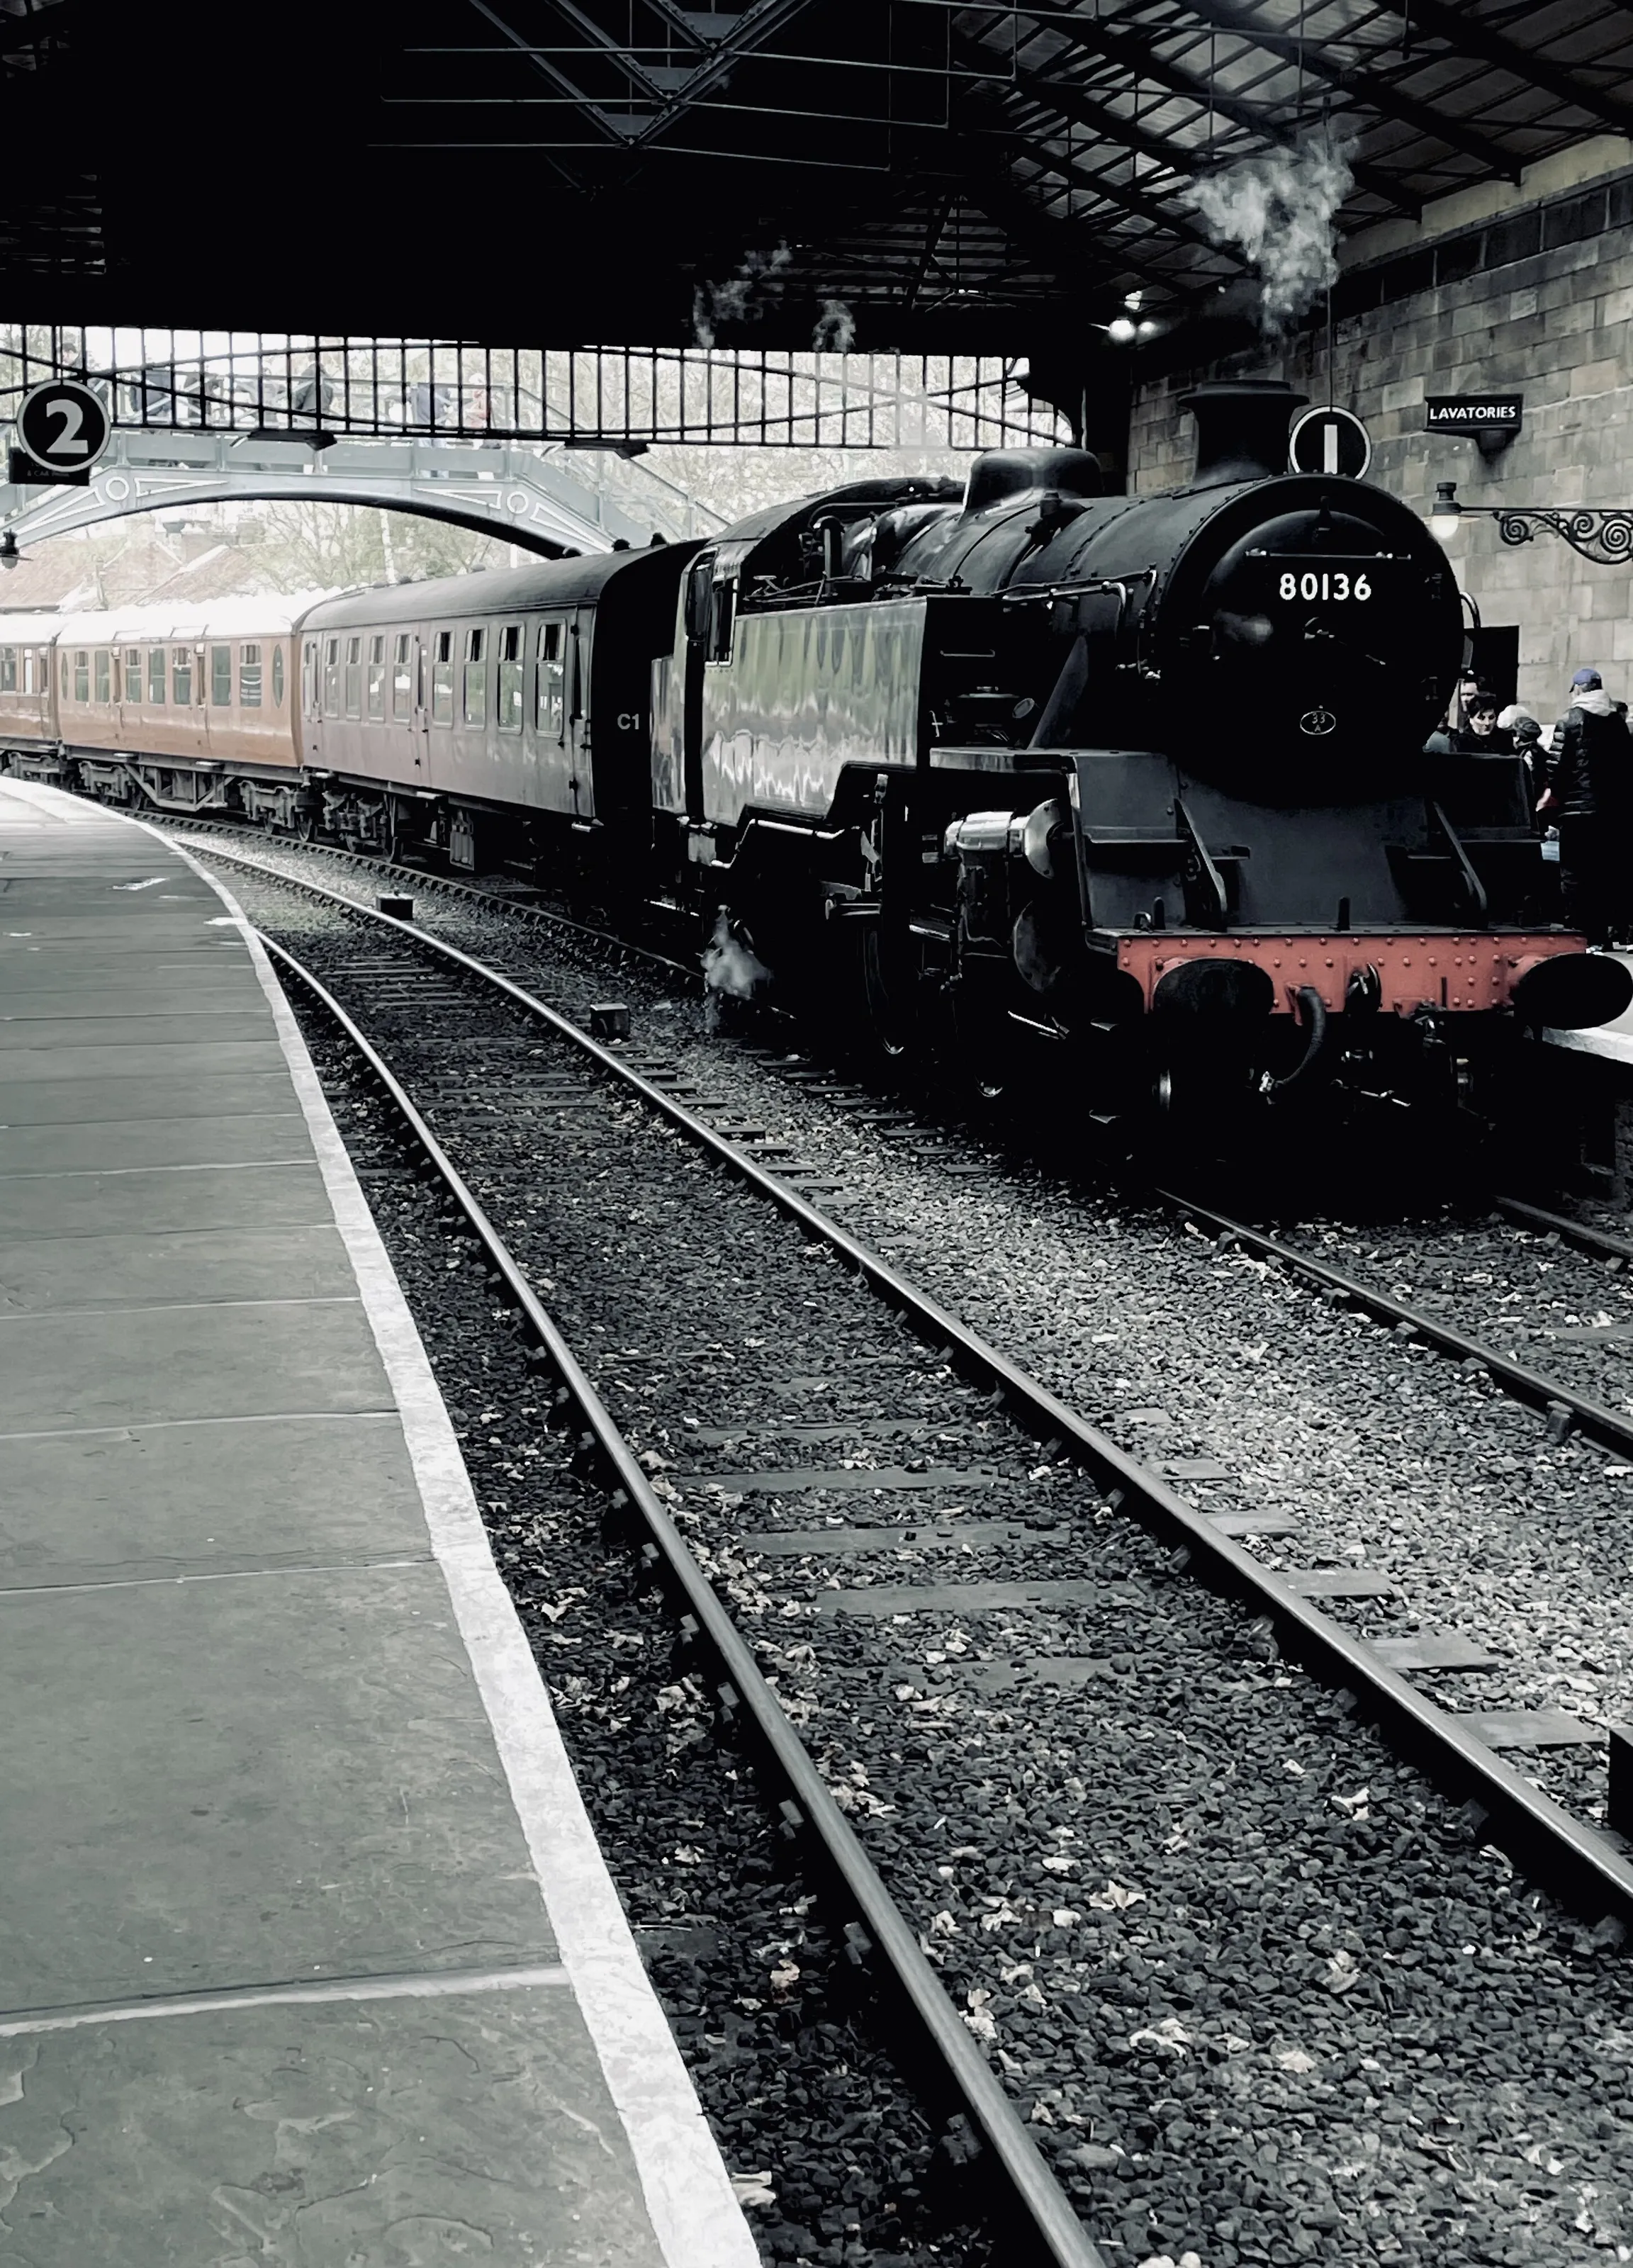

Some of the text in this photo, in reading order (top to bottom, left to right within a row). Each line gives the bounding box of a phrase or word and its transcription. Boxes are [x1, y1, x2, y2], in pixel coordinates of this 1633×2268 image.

[1429, 405, 1516, 420] LAVATORIES
[46, 399, 89, 454] 2
[1324, 424, 1338, 474] 1
[1279, 573, 1372, 602] 80136
[617, 713, 640, 730] C1
[1311, 712, 1326, 724] 33
